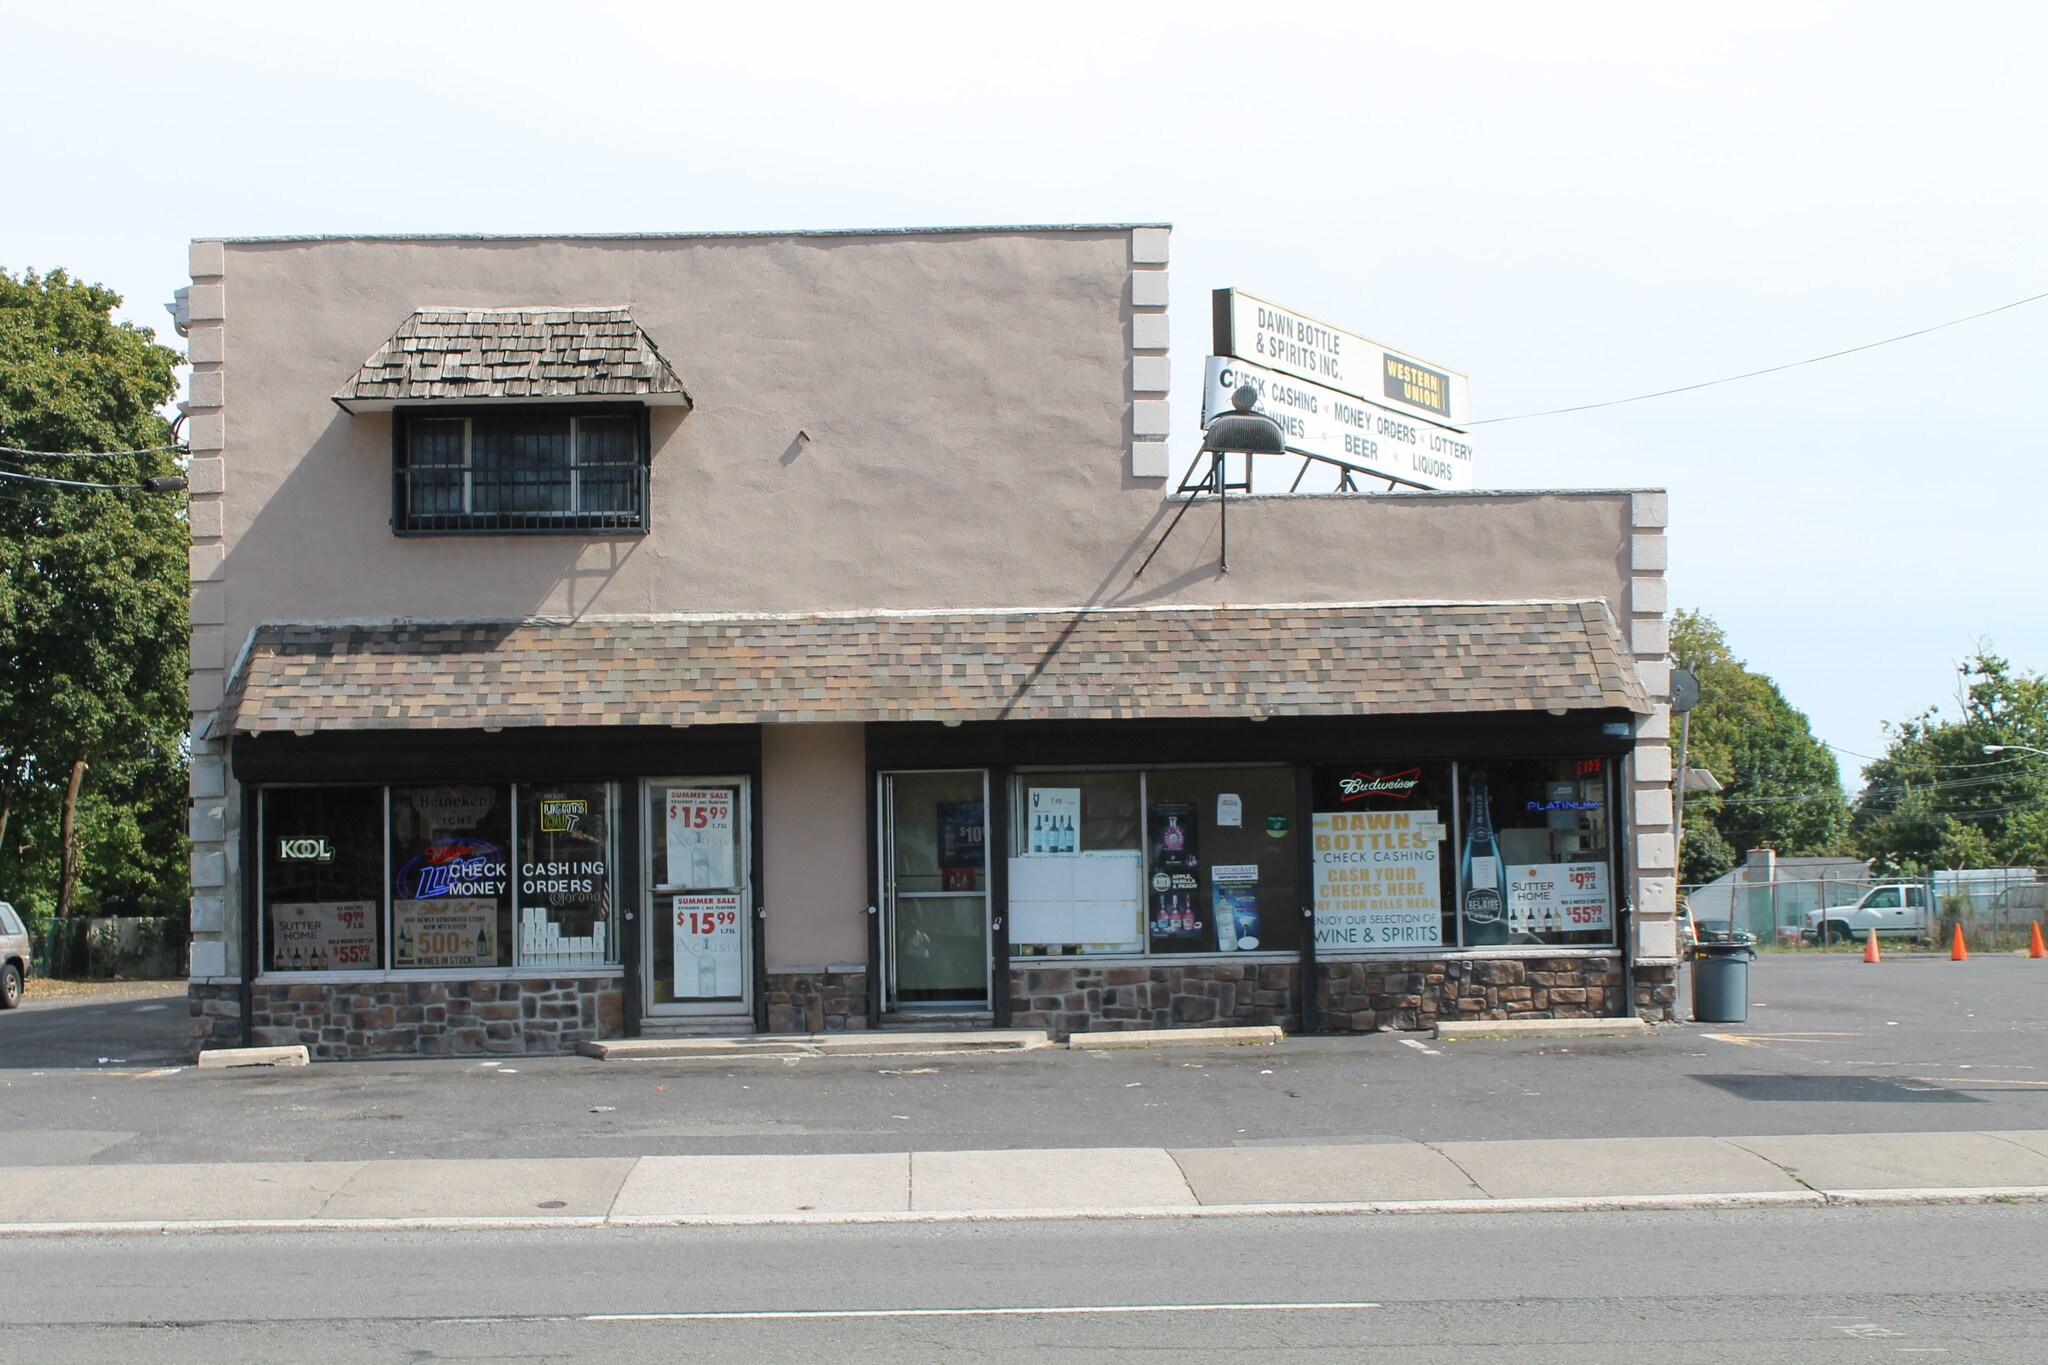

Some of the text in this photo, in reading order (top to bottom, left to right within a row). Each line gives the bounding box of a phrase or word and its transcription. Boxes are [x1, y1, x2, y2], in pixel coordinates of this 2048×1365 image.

[1258, 307, 1340, 356] DAWN BOTTLE
[1256, 333, 1343, 381] & SPIRITS INC.
[1387, 359, 1439, 391] WESTERN
[1403, 382, 1440, 409] UNION
[1272, 383, 1318, 414] CASHING
[1334, 402, 1372, 432] MONEY
[1377, 416, 1416, 446] ORDERS
[1430, 434, 1473, 462] LOTTERY
[1345, 434, 1378, 460] BEER
[1413, 454, 1452, 481] LIQUORS
[1340, 779, 1418, 794] Budweiser
[420, 796, 487, 808] Heineken
[544, 803, 585, 814] LIGHTS
[1527, 801, 1600, 811] PLATINUM
[545, 814, 579, 832] OUT
[1331, 813, 1410, 831] DAWN
[281, 839, 331, 858] KOOL
[669, 837, 730, 846] EXCUSIV
[1315, 832, 1427, 850] BOTTLES
[1324, 850, 1435, 863] CHECK CASHING
[450, 862, 604, 877] CHECK CASHING
[1328, 867, 1416, 882] CASH YOUR
[449, 879, 593, 896] MONEY ORDERS
[1320, 882, 1425, 898] CHECKS HERE
[1512, 882, 1555, 892] SUTTER
[550, 892, 600, 906] Corona
[1335, 900, 1367, 910] YOUR
[1371, 899, 1403, 909] BILLS
[1406, 898, 1437, 908] HERE
[1518, 892, 1550, 901] HOME
[1468, 900, 1500, 910] BELAIRE
[279, 921, 321, 931] SUTTER
[1346, 915, 1367, 925] OUR
[1370, 914, 1421, 924] SELECTION
[1423, 913, 1437, 923] OF
[284, 931, 317, 941] HOME
[1314, 926, 1438, 943] WINE & SPIRITS
[418, 932, 474, 955] 500+
[417, 956, 475, 965] WINES IN STOCK!
